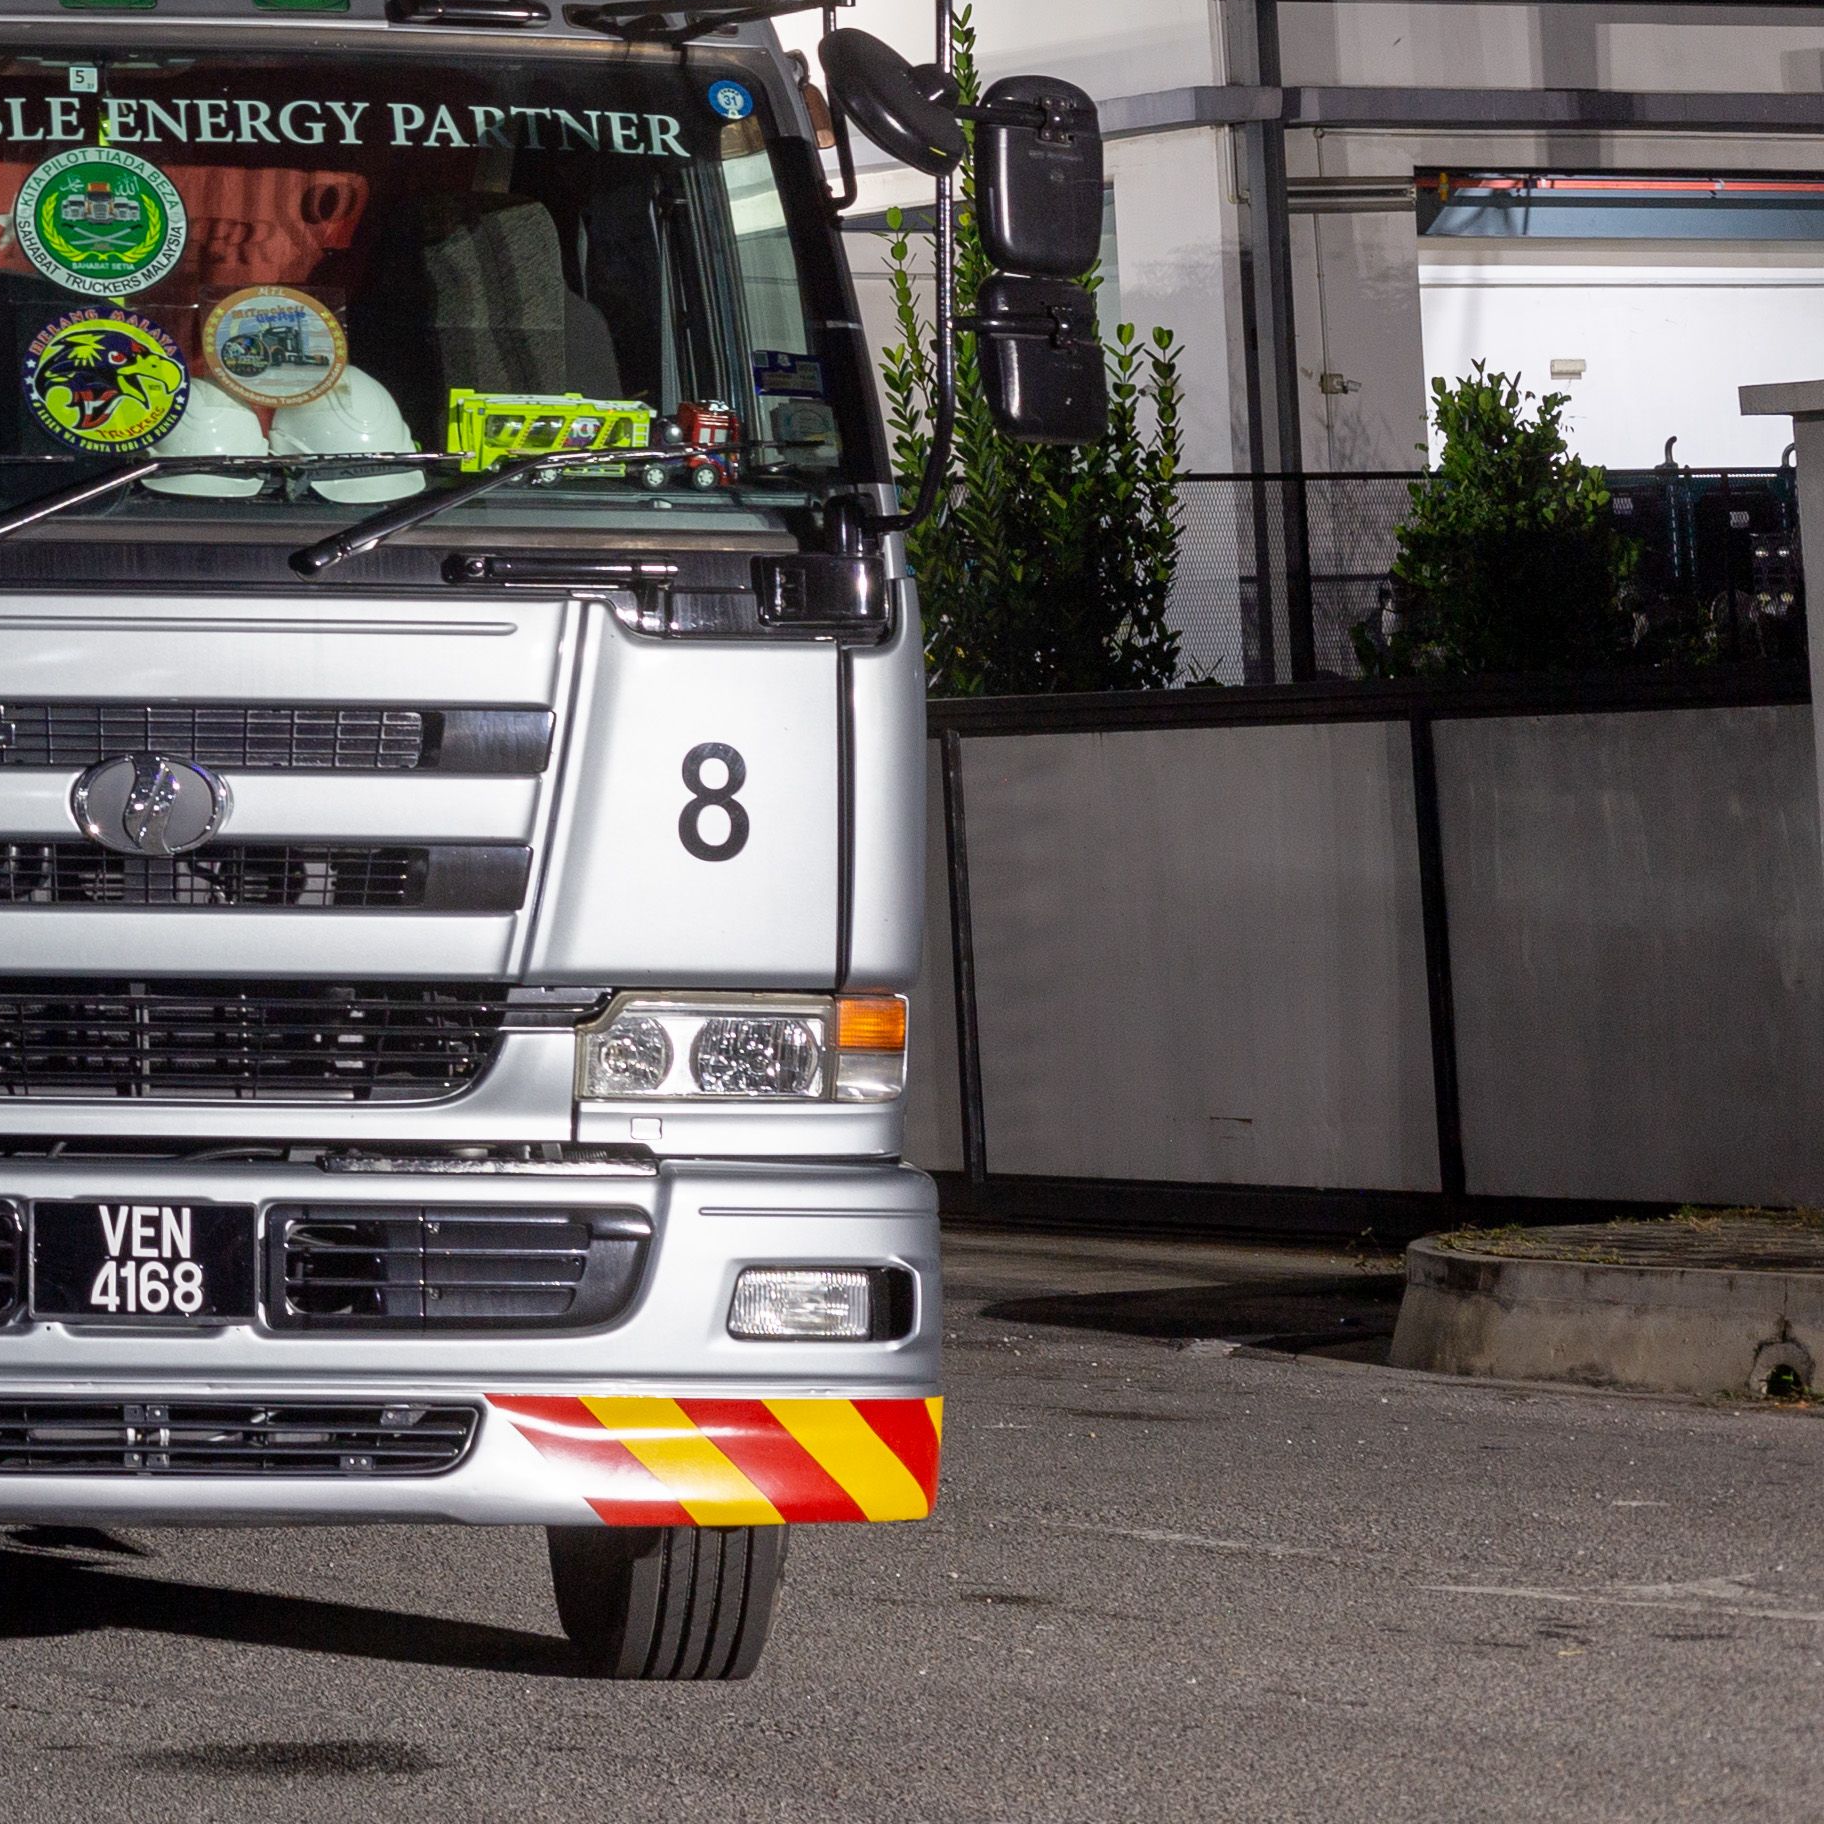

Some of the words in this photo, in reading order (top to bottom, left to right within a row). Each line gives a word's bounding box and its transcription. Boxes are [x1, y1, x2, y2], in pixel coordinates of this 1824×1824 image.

[75, 69, 86, 84] 5
[723, 94, 739, 107] 31
[107, 96, 366, 148] ENERGY
[388, 103, 694, 160] PARTNER
[20, 176, 46, 208] KITA
[45, 150, 90, 176] PILOT
[95, 149, 146, 175] TIADA
[146, 170, 180, 210] BEZA
[18, 220, 62, 275] SAHABAT
[64, 272, 143, 294] TRUCKERS
[142, 225, 184, 282] MALAYSIA
[28, 309, 99, 357] HELANG
[109, 309, 178, 357] MALAYA
[678, 741, 752, 863] 8
[97, 1204, 194, 1260] VEN
[89, 1260, 203, 1317] 4168
